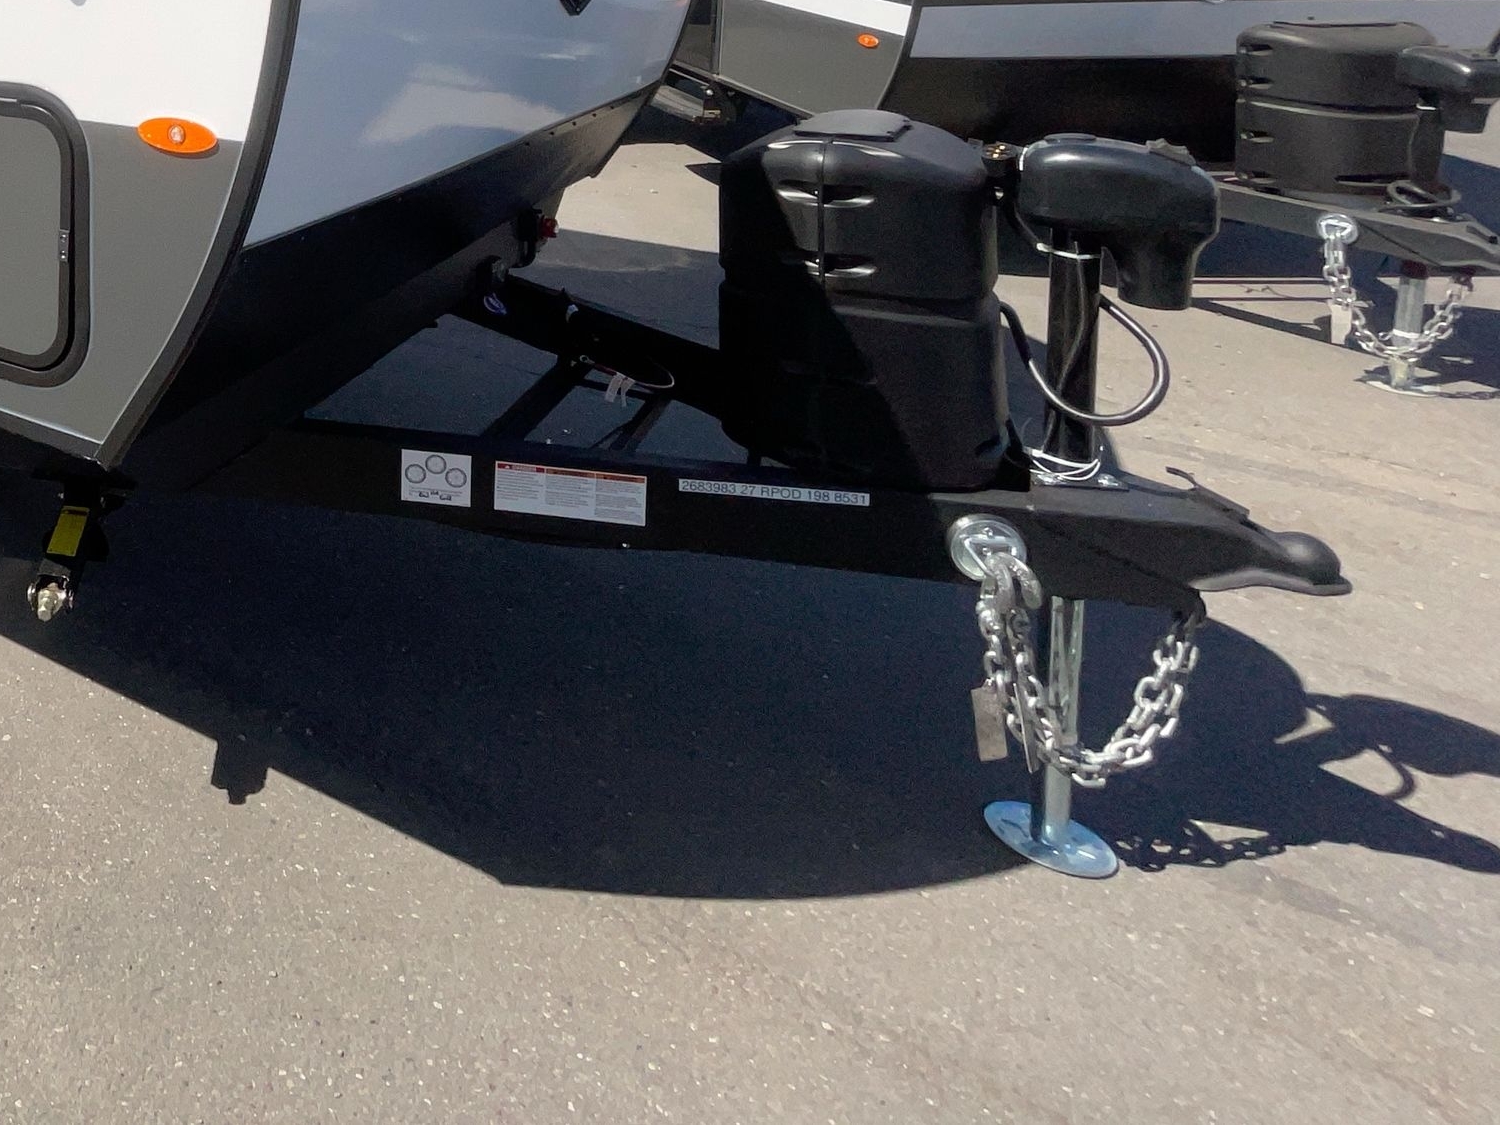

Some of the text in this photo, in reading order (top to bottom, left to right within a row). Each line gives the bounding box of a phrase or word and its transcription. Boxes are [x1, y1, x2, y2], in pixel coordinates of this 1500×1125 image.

[681, 480, 867, 505] 2683983 27 RPOD 198 8531
